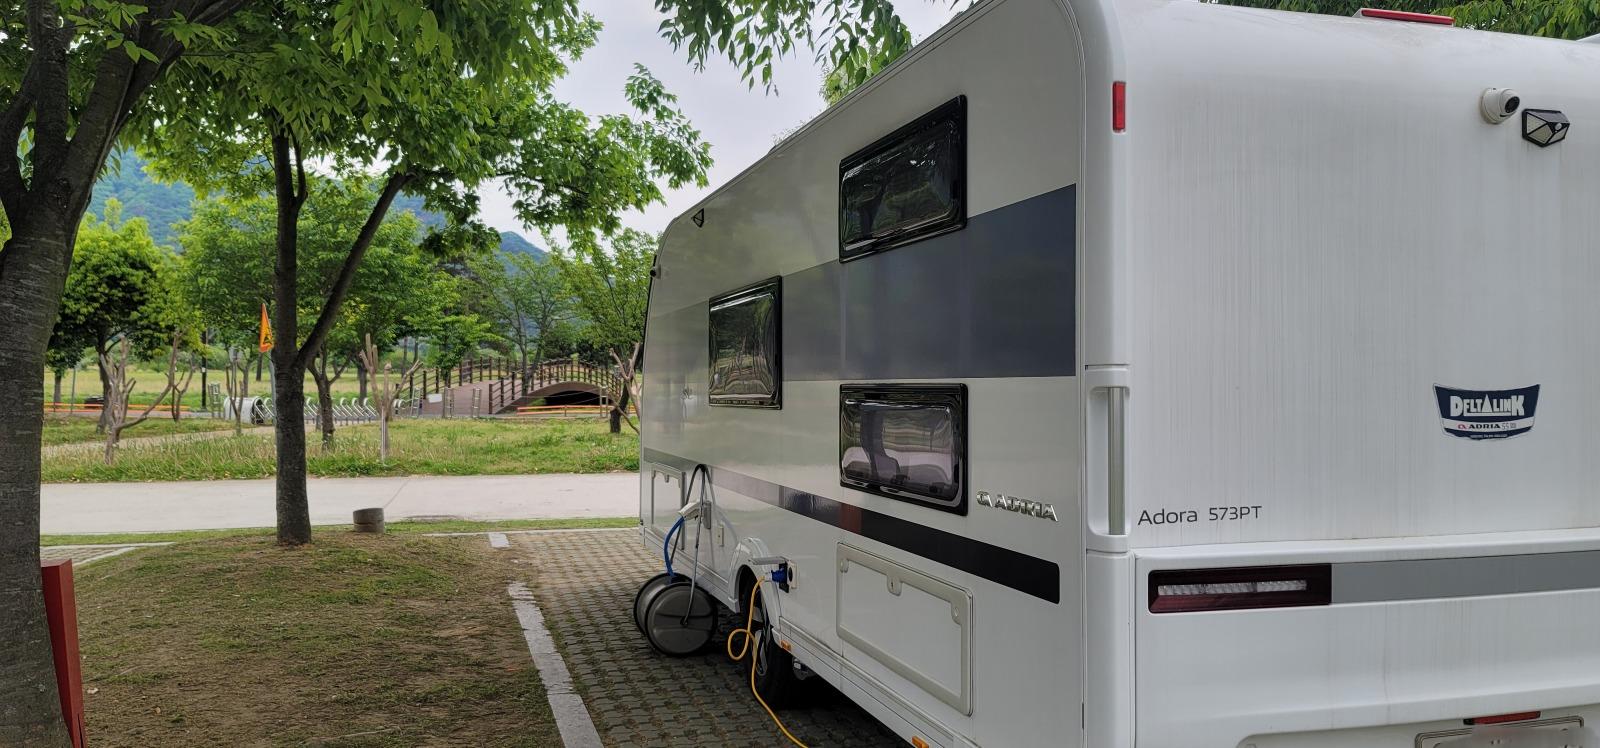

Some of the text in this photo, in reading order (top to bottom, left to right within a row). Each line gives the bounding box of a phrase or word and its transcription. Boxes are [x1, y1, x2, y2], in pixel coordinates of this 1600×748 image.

[994, 494, 1059, 522] ADRIA
[1137, 505, 1262, 525] Adora 573PT
